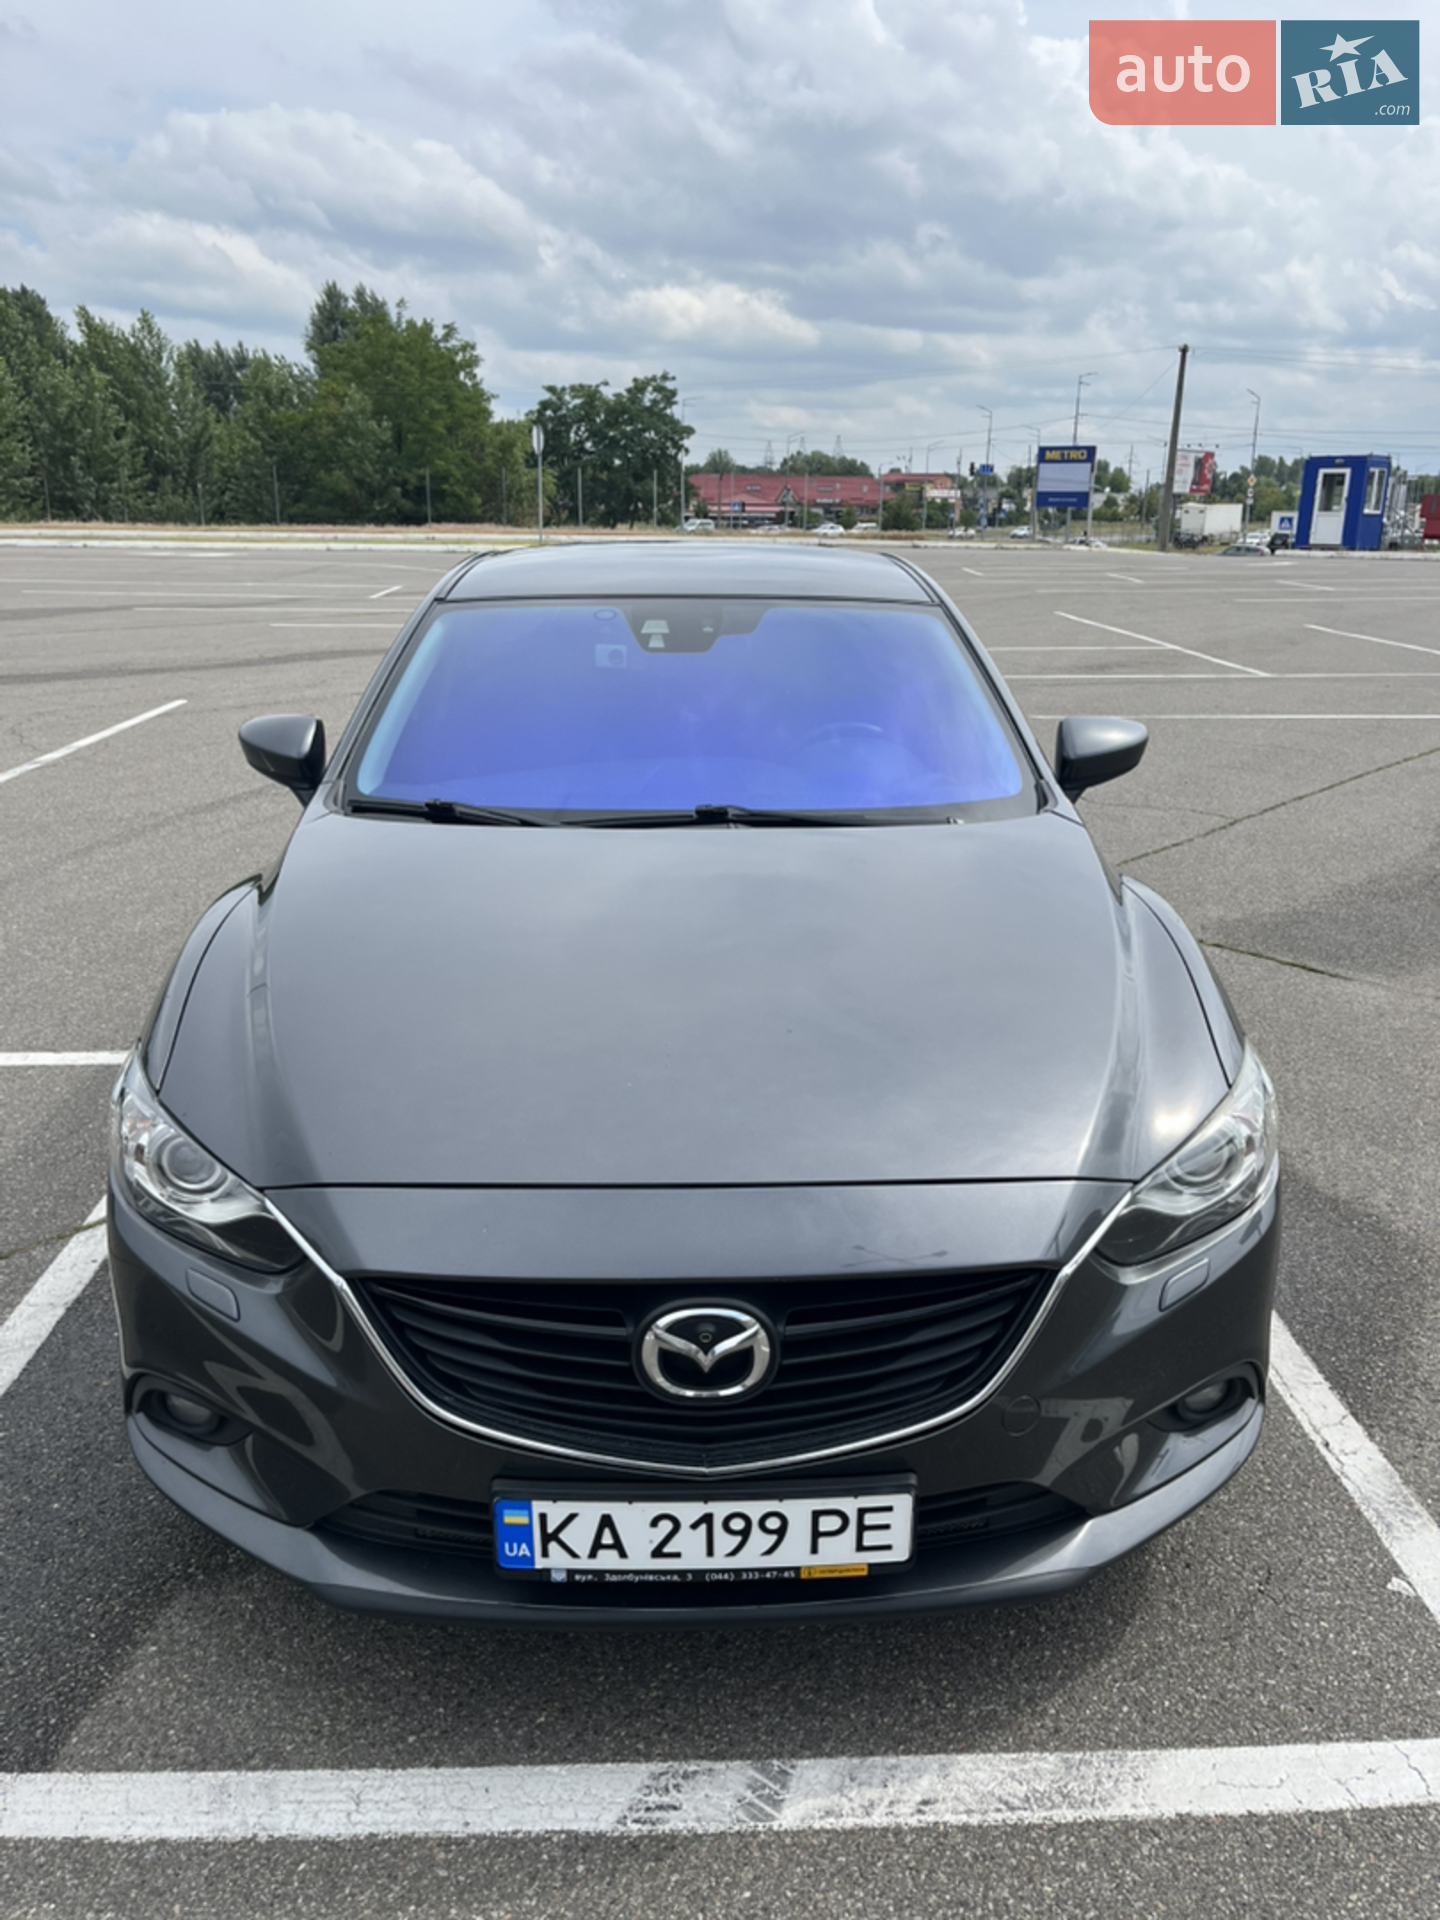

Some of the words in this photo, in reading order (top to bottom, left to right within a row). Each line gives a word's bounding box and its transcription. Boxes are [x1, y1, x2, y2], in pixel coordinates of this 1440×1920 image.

[1045, 449, 1088, 460] METRO
[537, 1512, 629, 1560] KA
[648, 1510, 790, 1559] 2199
[809, 1505, 895, 1556] PE
[503, 1541, 531, 1558] UA
[705, 1571, 735, 1582] (044)
[740, 1569, 796, 1580] 333-47-45
